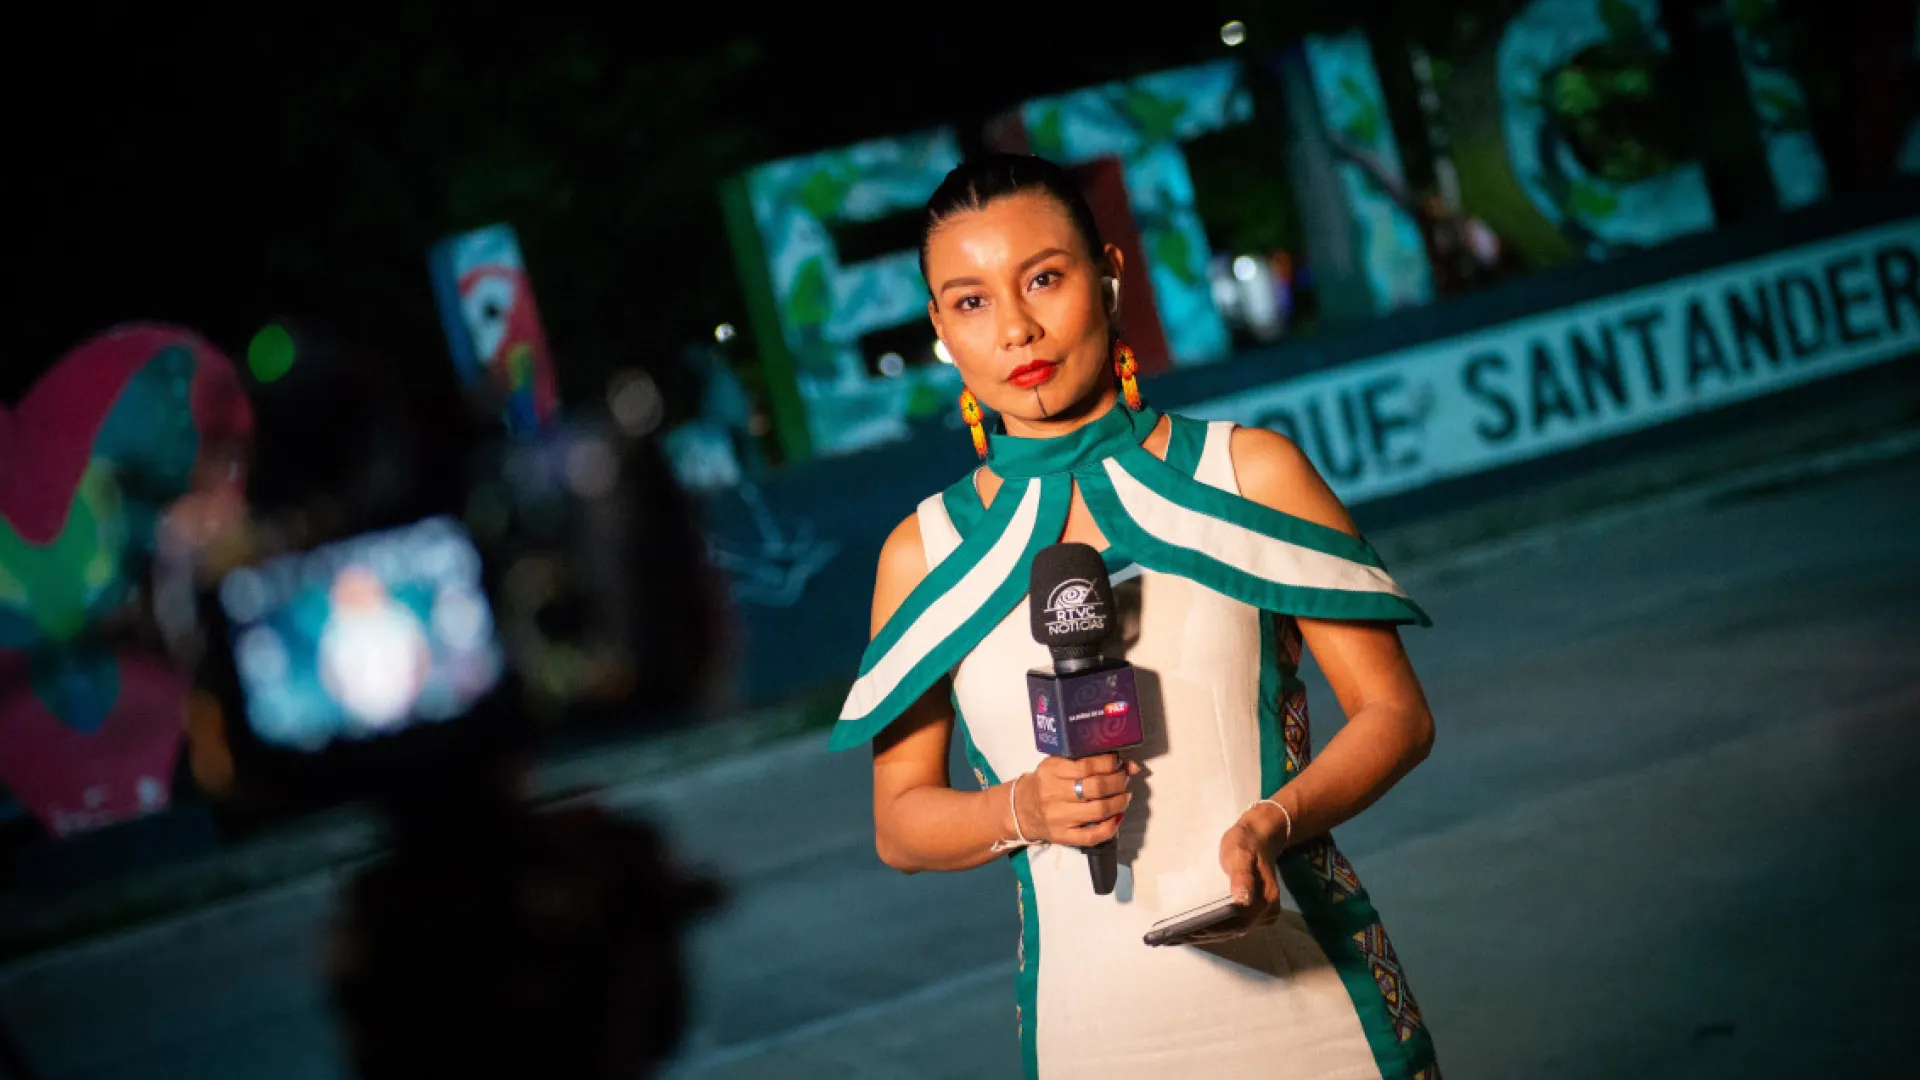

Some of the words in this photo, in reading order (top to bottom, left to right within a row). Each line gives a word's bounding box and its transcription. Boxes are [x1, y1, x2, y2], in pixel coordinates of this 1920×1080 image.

[430, 0, 1920, 490] LETICI
[1462, 245, 1920, 443] SANTANDER
[1048, 617, 1104, 635] NOTICIAS
[1056, 605, 1096, 622] RTVC
